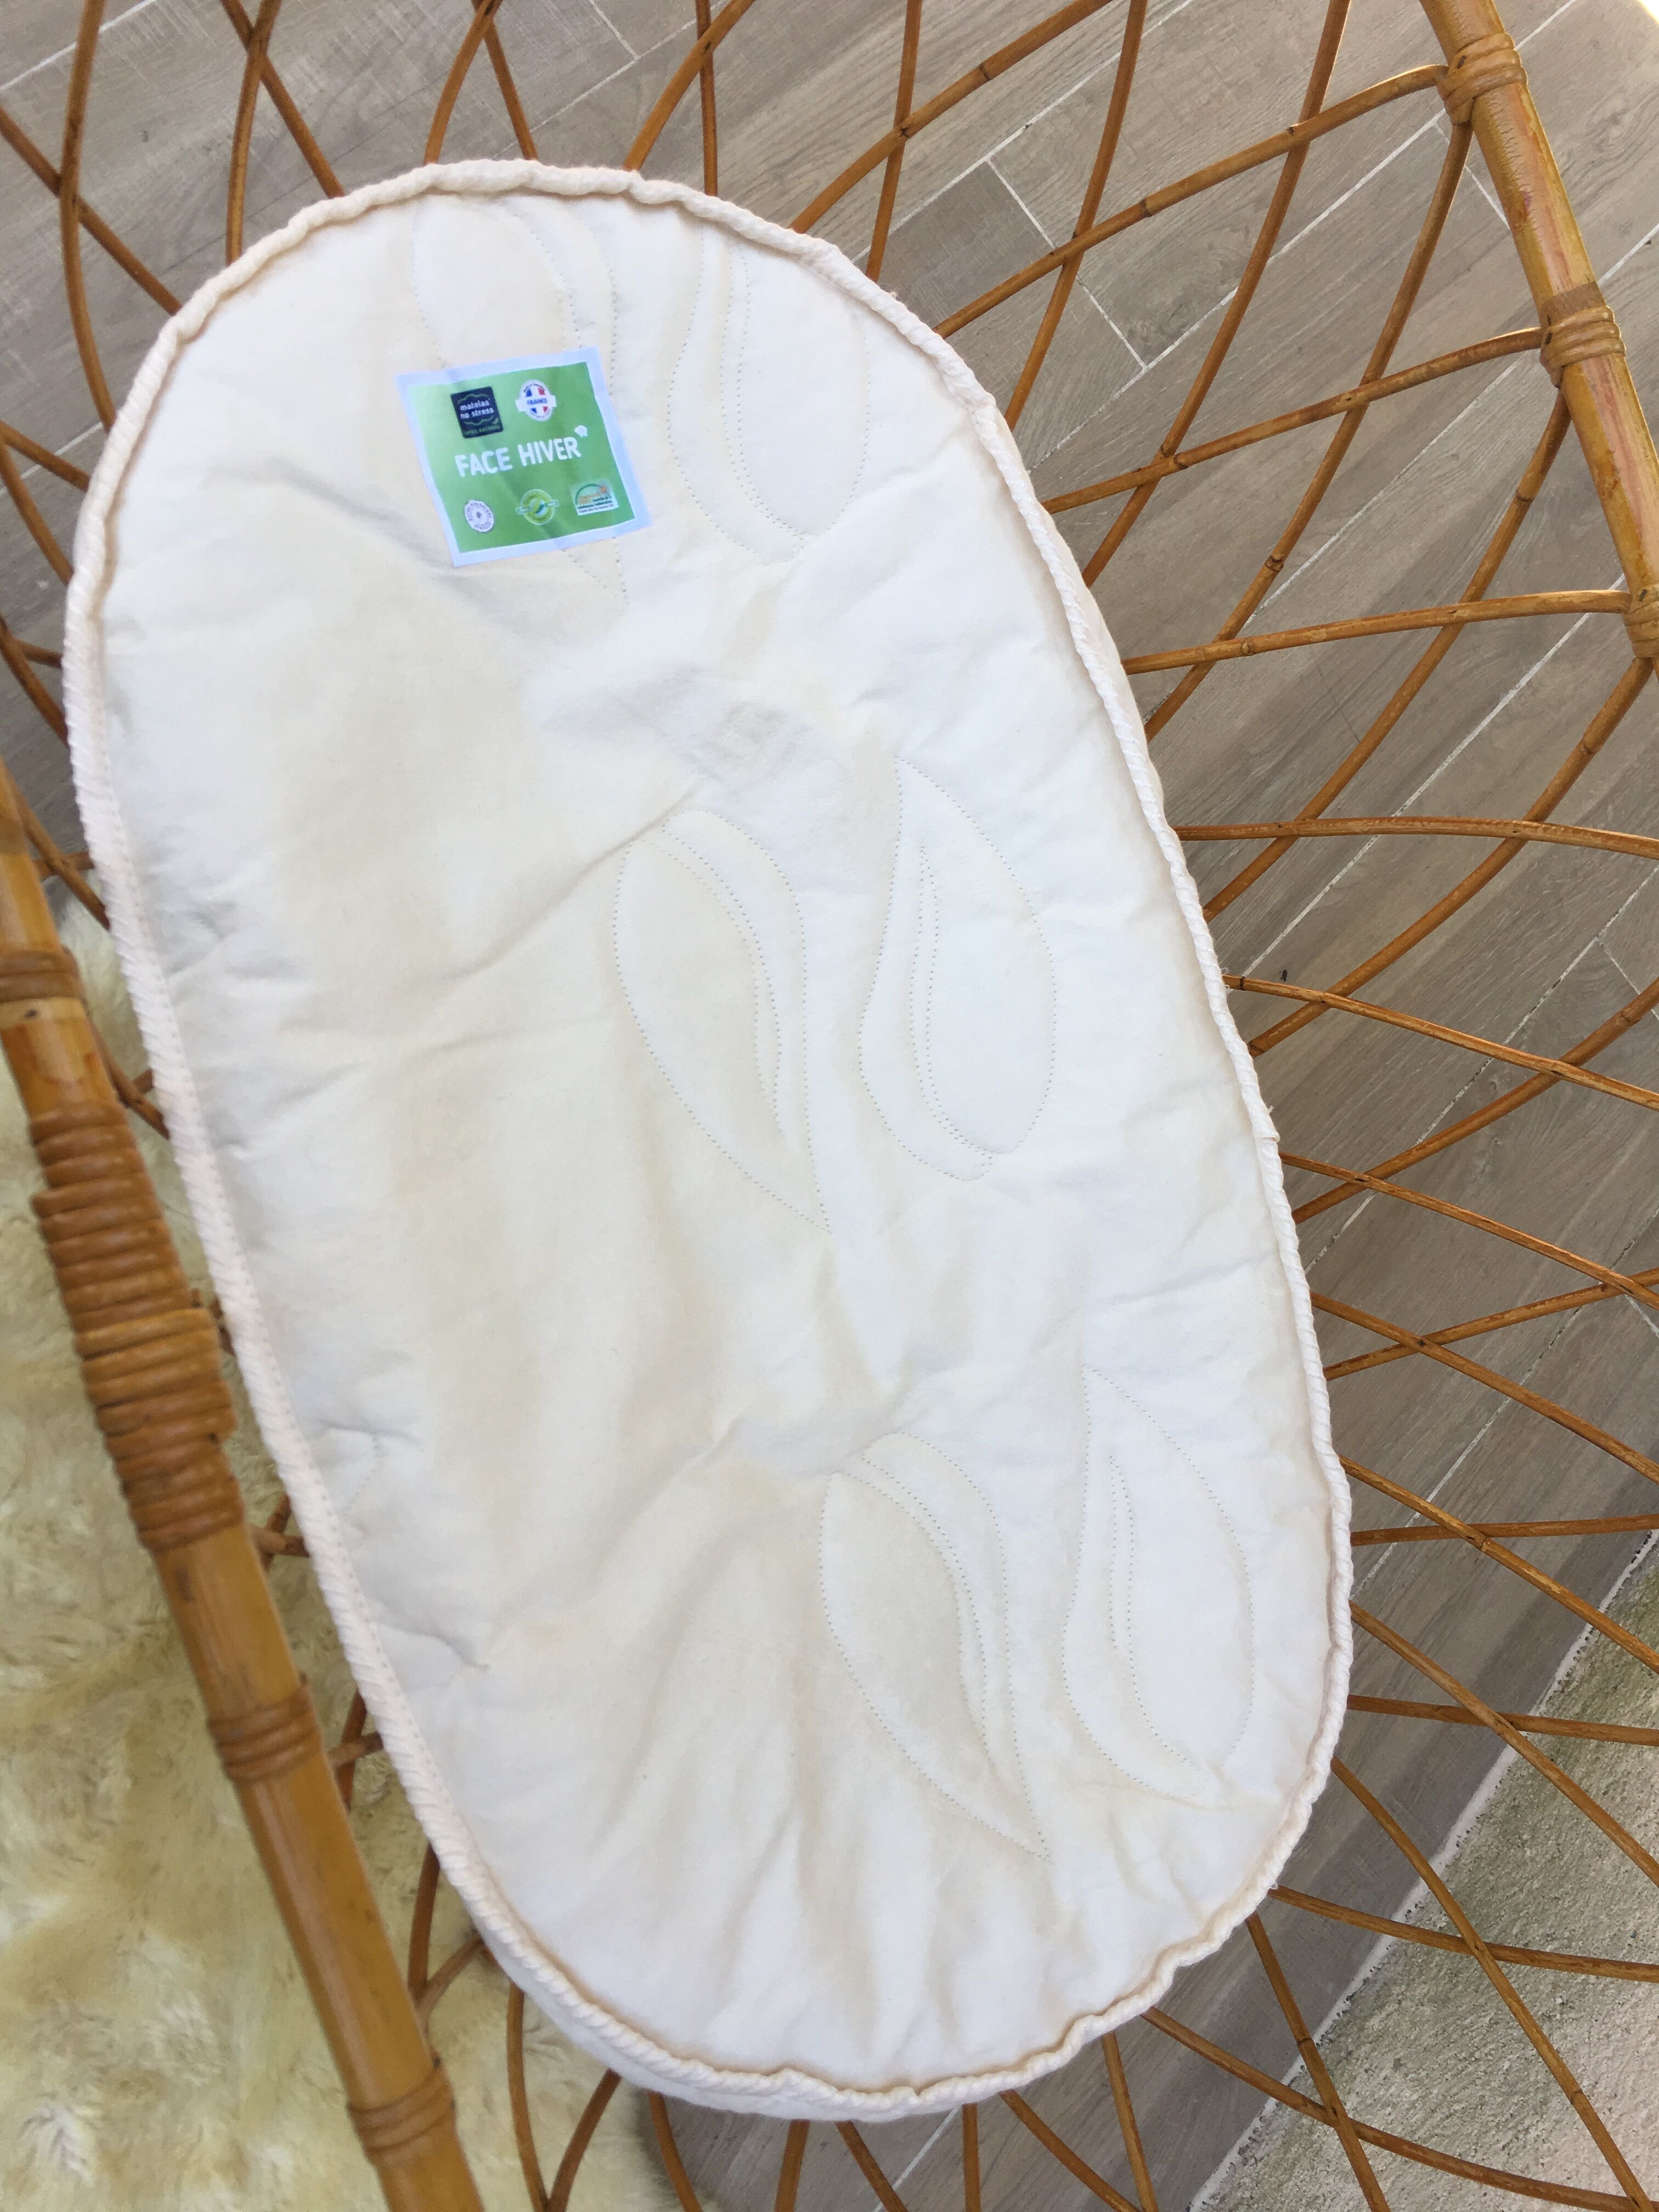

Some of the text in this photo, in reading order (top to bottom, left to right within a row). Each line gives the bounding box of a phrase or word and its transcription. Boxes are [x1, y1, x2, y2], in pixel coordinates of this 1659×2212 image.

[460, 400, 489, 411] matelas
[471, 408, 494, 417] stress
[455, 437, 582, 477] FACE HIVER
